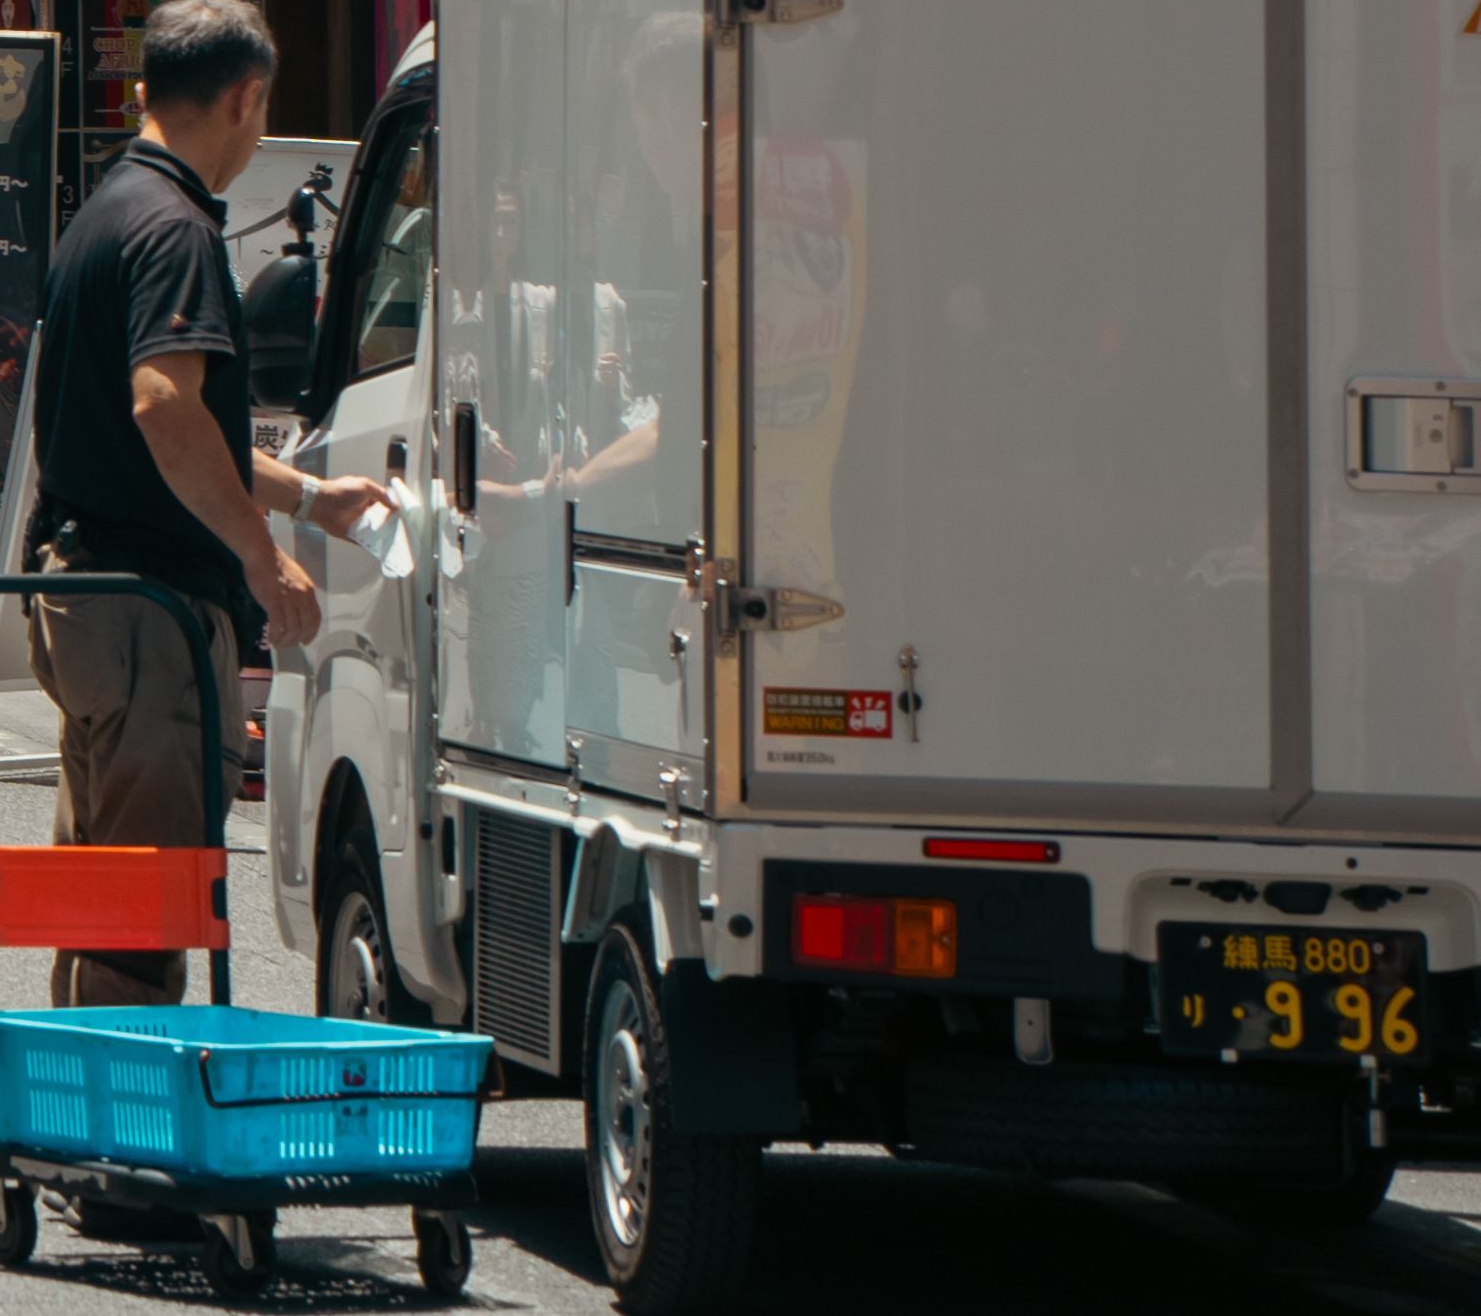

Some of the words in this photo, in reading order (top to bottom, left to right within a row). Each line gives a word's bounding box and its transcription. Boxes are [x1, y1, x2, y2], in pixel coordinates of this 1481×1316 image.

[768, 717, 844, 730] WARNING
[1223, 936, 1297, 971] 練馬
[1305, 939, 1370, 974] 880
